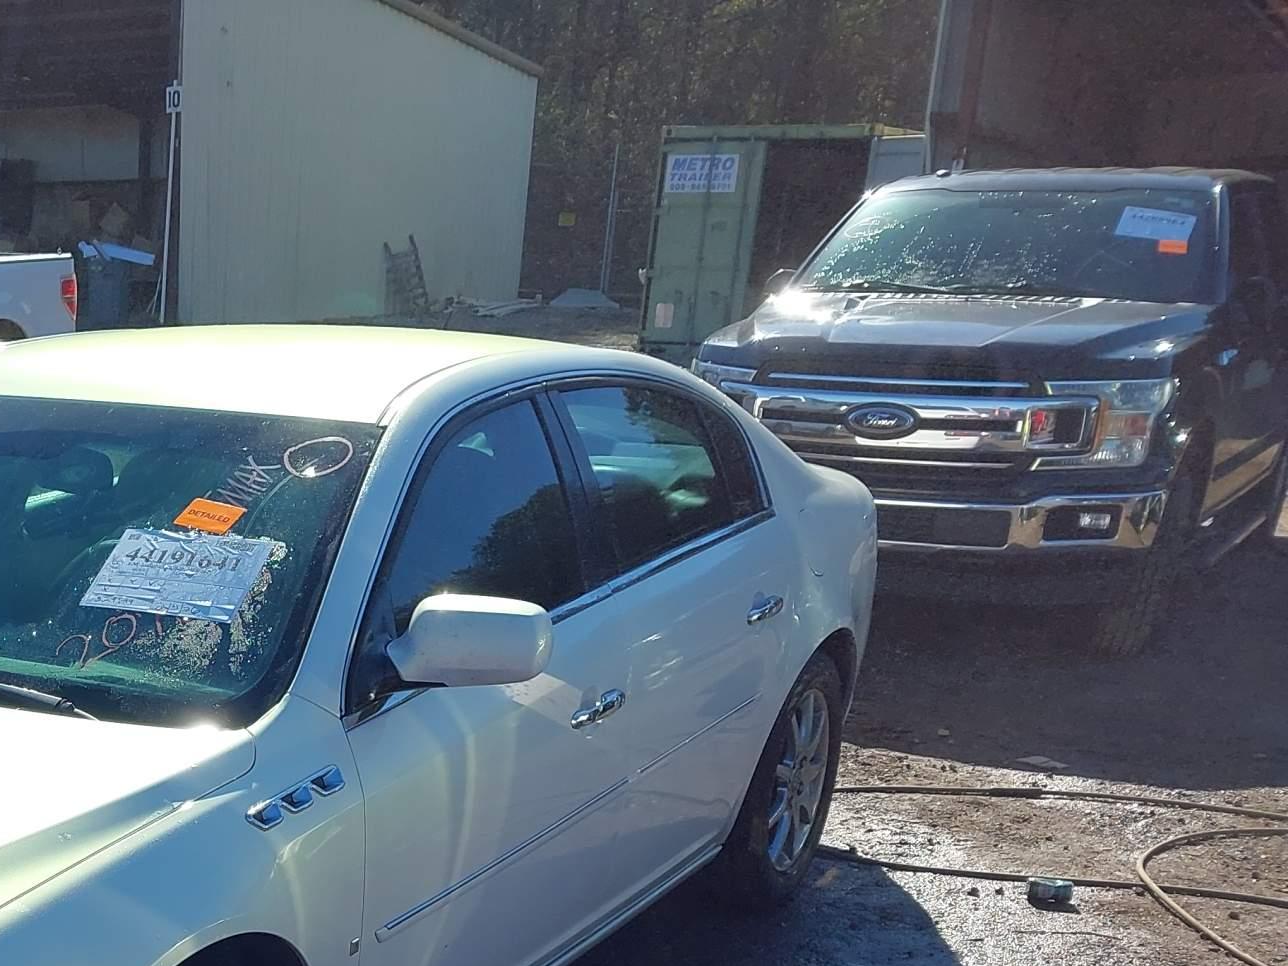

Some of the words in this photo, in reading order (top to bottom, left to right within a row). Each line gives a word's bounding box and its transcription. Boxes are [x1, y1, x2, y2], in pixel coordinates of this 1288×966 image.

[168, 90, 181, 108] 10
[671, 157, 735, 171] METRO
[670, 172, 733, 181] TRAILER
[203, 455, 282, 504] MAX
[187, 509, 231, 523] DETAILED
[125, 547, 241, 571] 44191641
